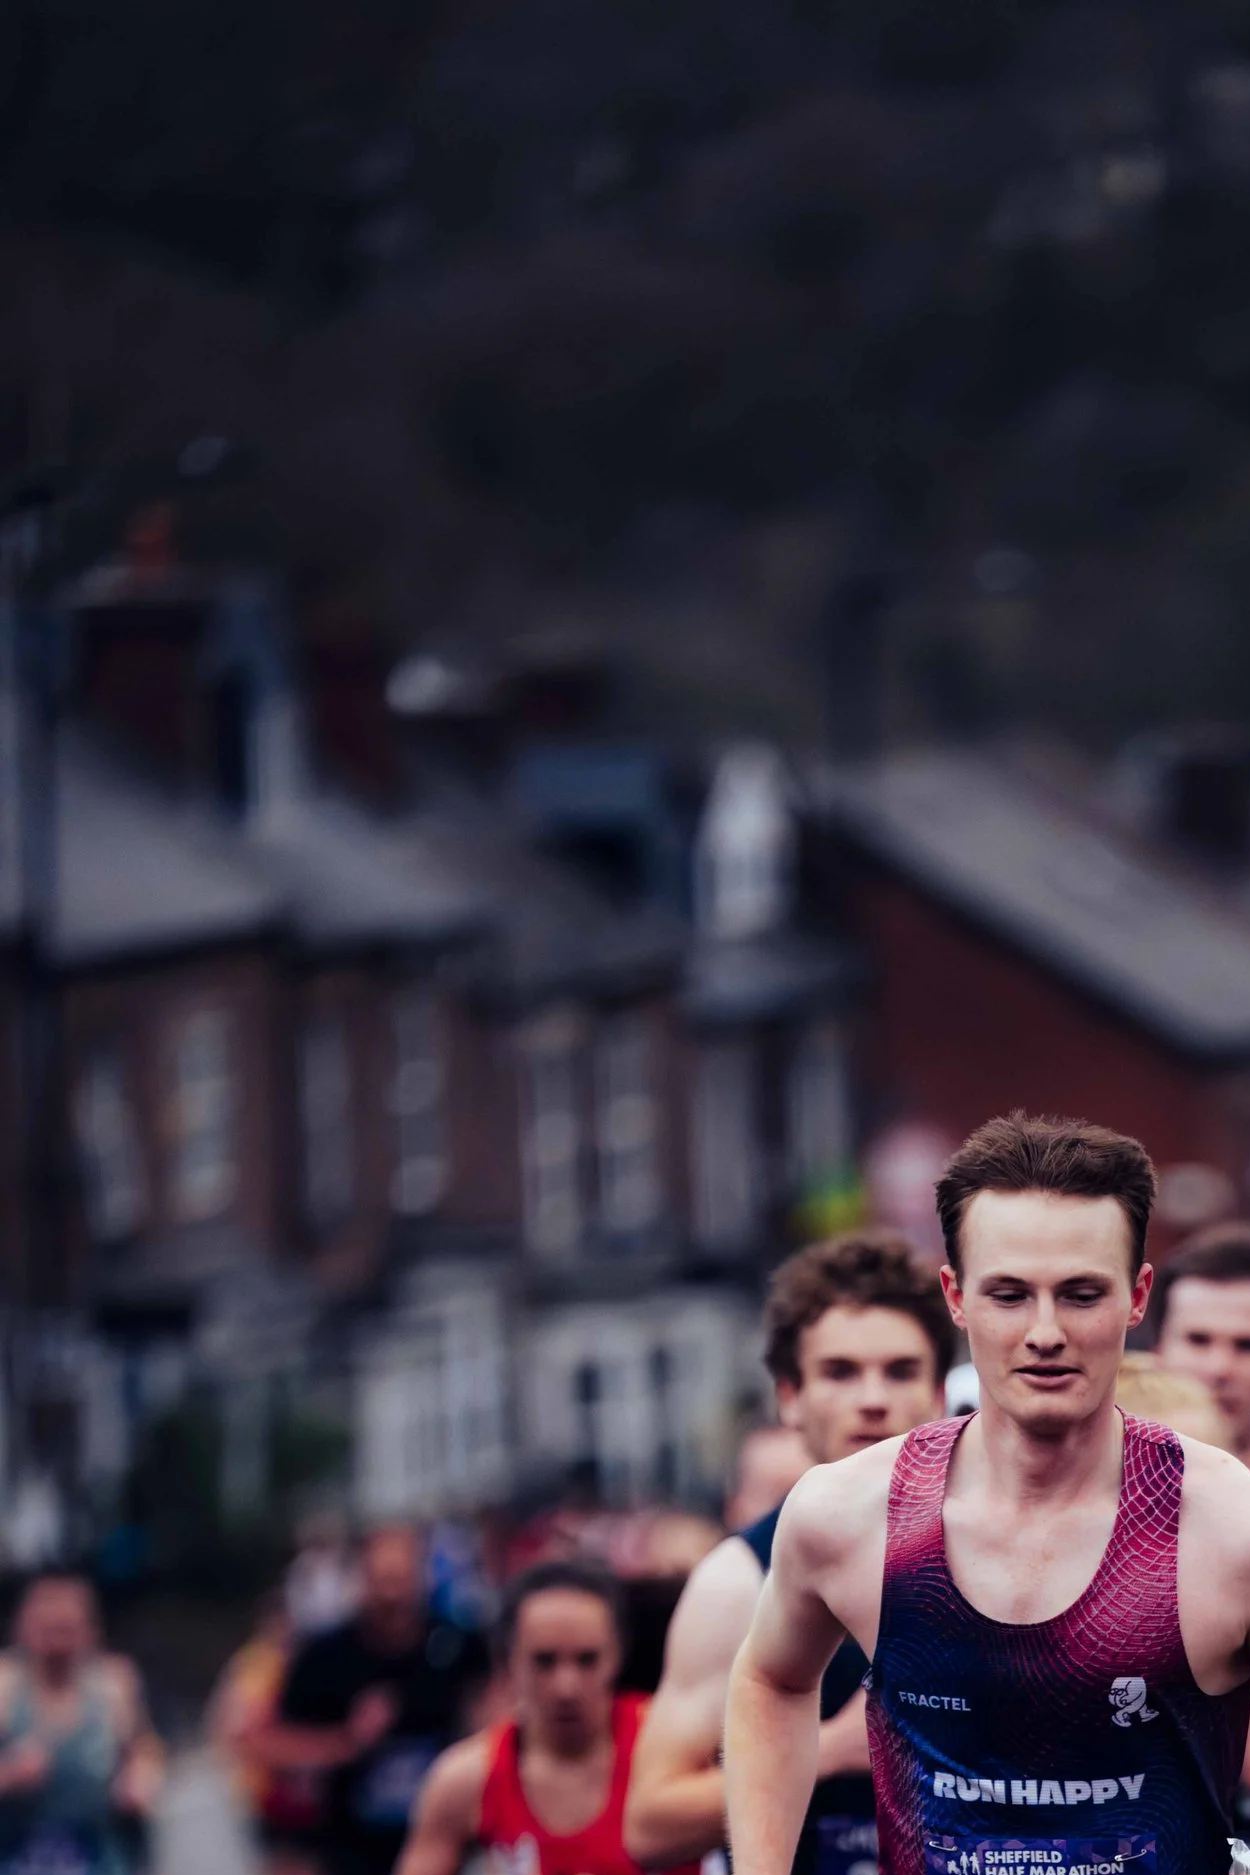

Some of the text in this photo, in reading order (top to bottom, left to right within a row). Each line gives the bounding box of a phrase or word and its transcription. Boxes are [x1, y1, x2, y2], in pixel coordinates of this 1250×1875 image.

[898, 1691, 971, 1712] FRACTEL
[933, 1771, 1145, 1805] RUN HAPPY
[985, 1851, 1062, 1864] SHEFFIELD
